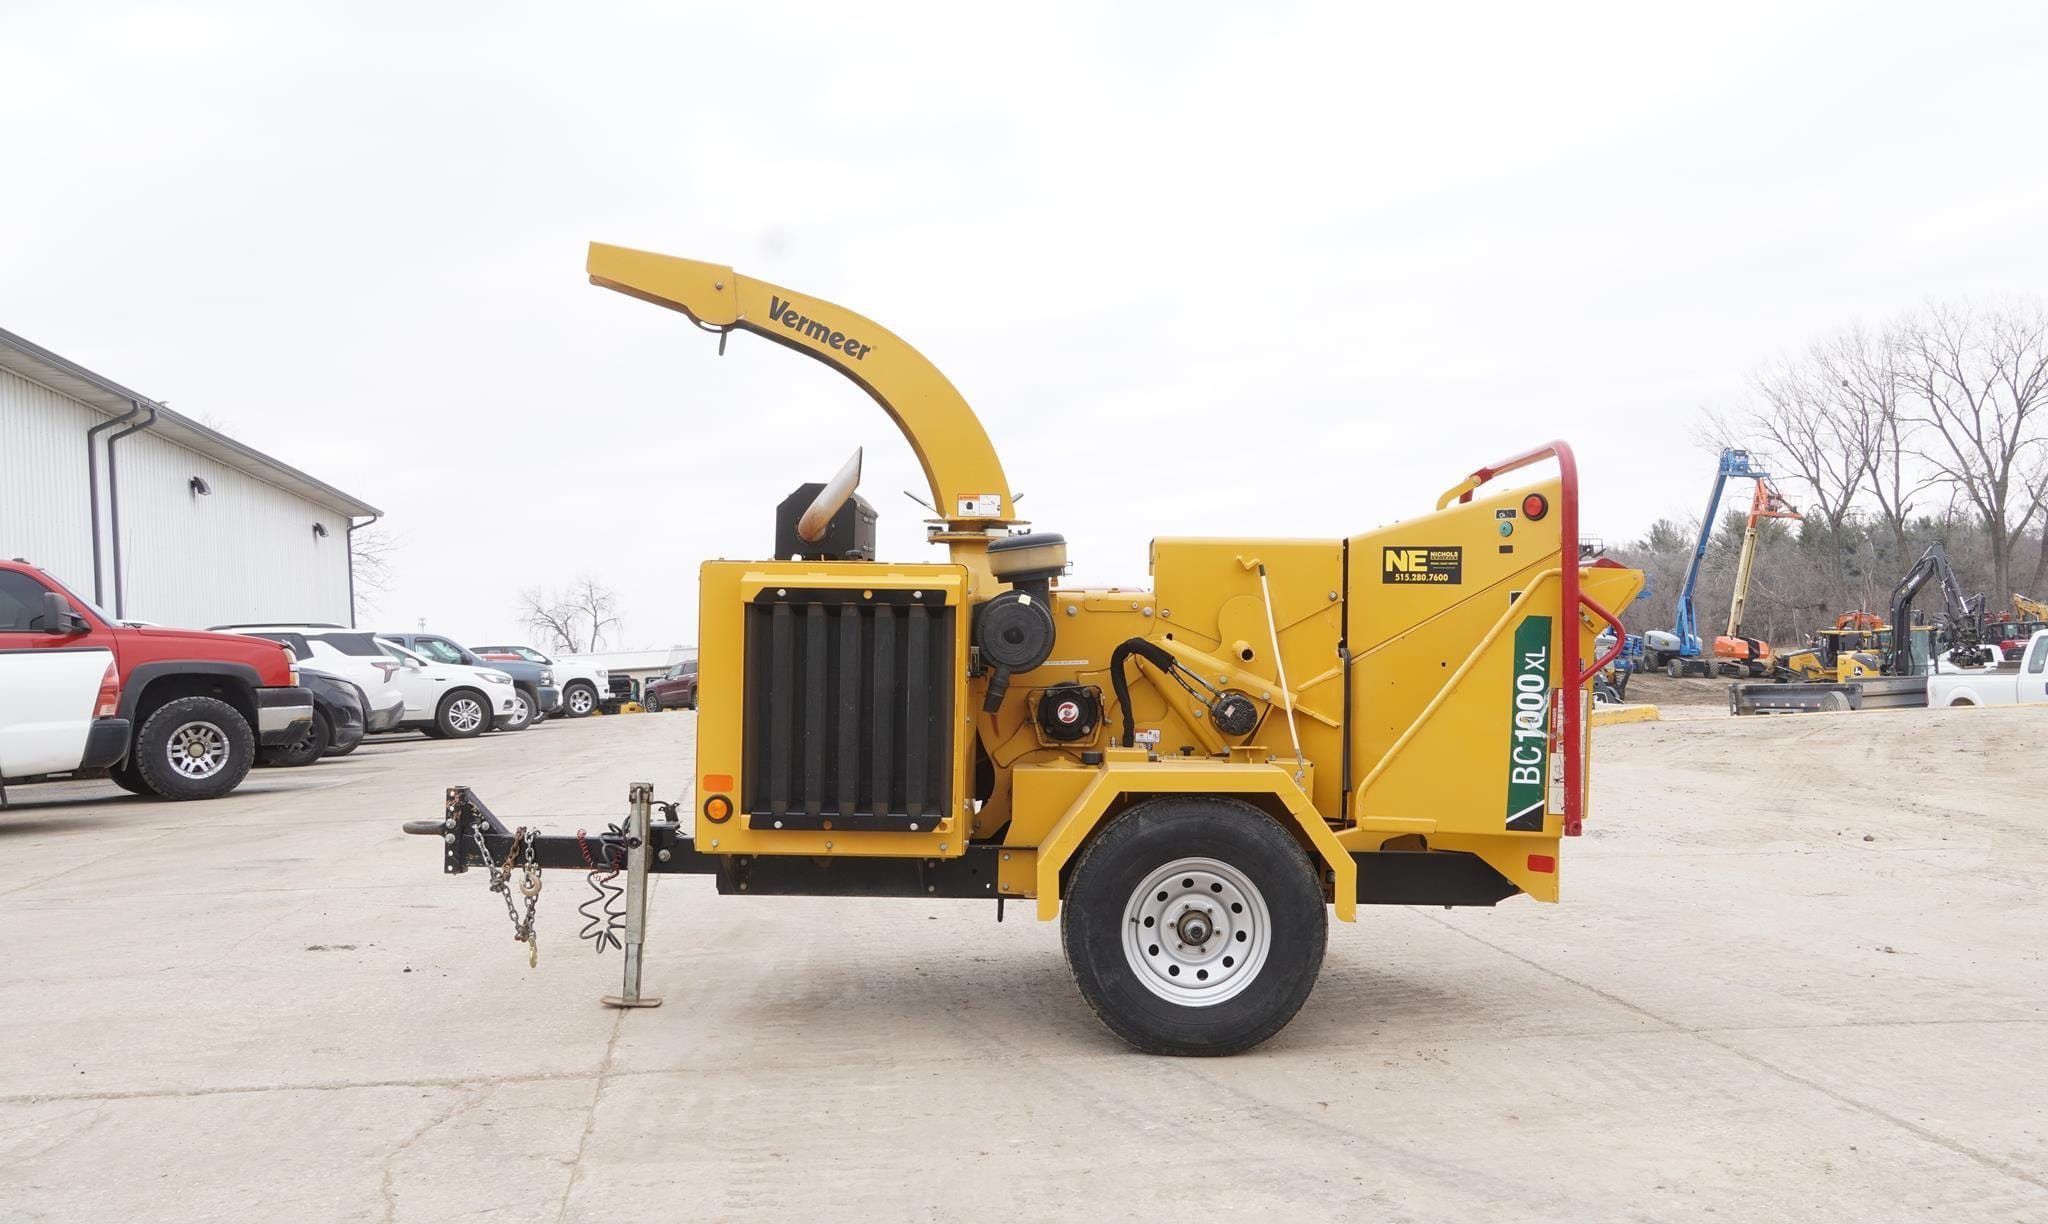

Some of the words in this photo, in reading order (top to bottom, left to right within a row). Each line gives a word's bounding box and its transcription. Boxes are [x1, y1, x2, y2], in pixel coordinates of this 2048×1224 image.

[769, 295, 871, 361] Vermeer
[1385, 550, 1428, 572] NE
[1395, 573, 1449, 582] 515.280.7600
